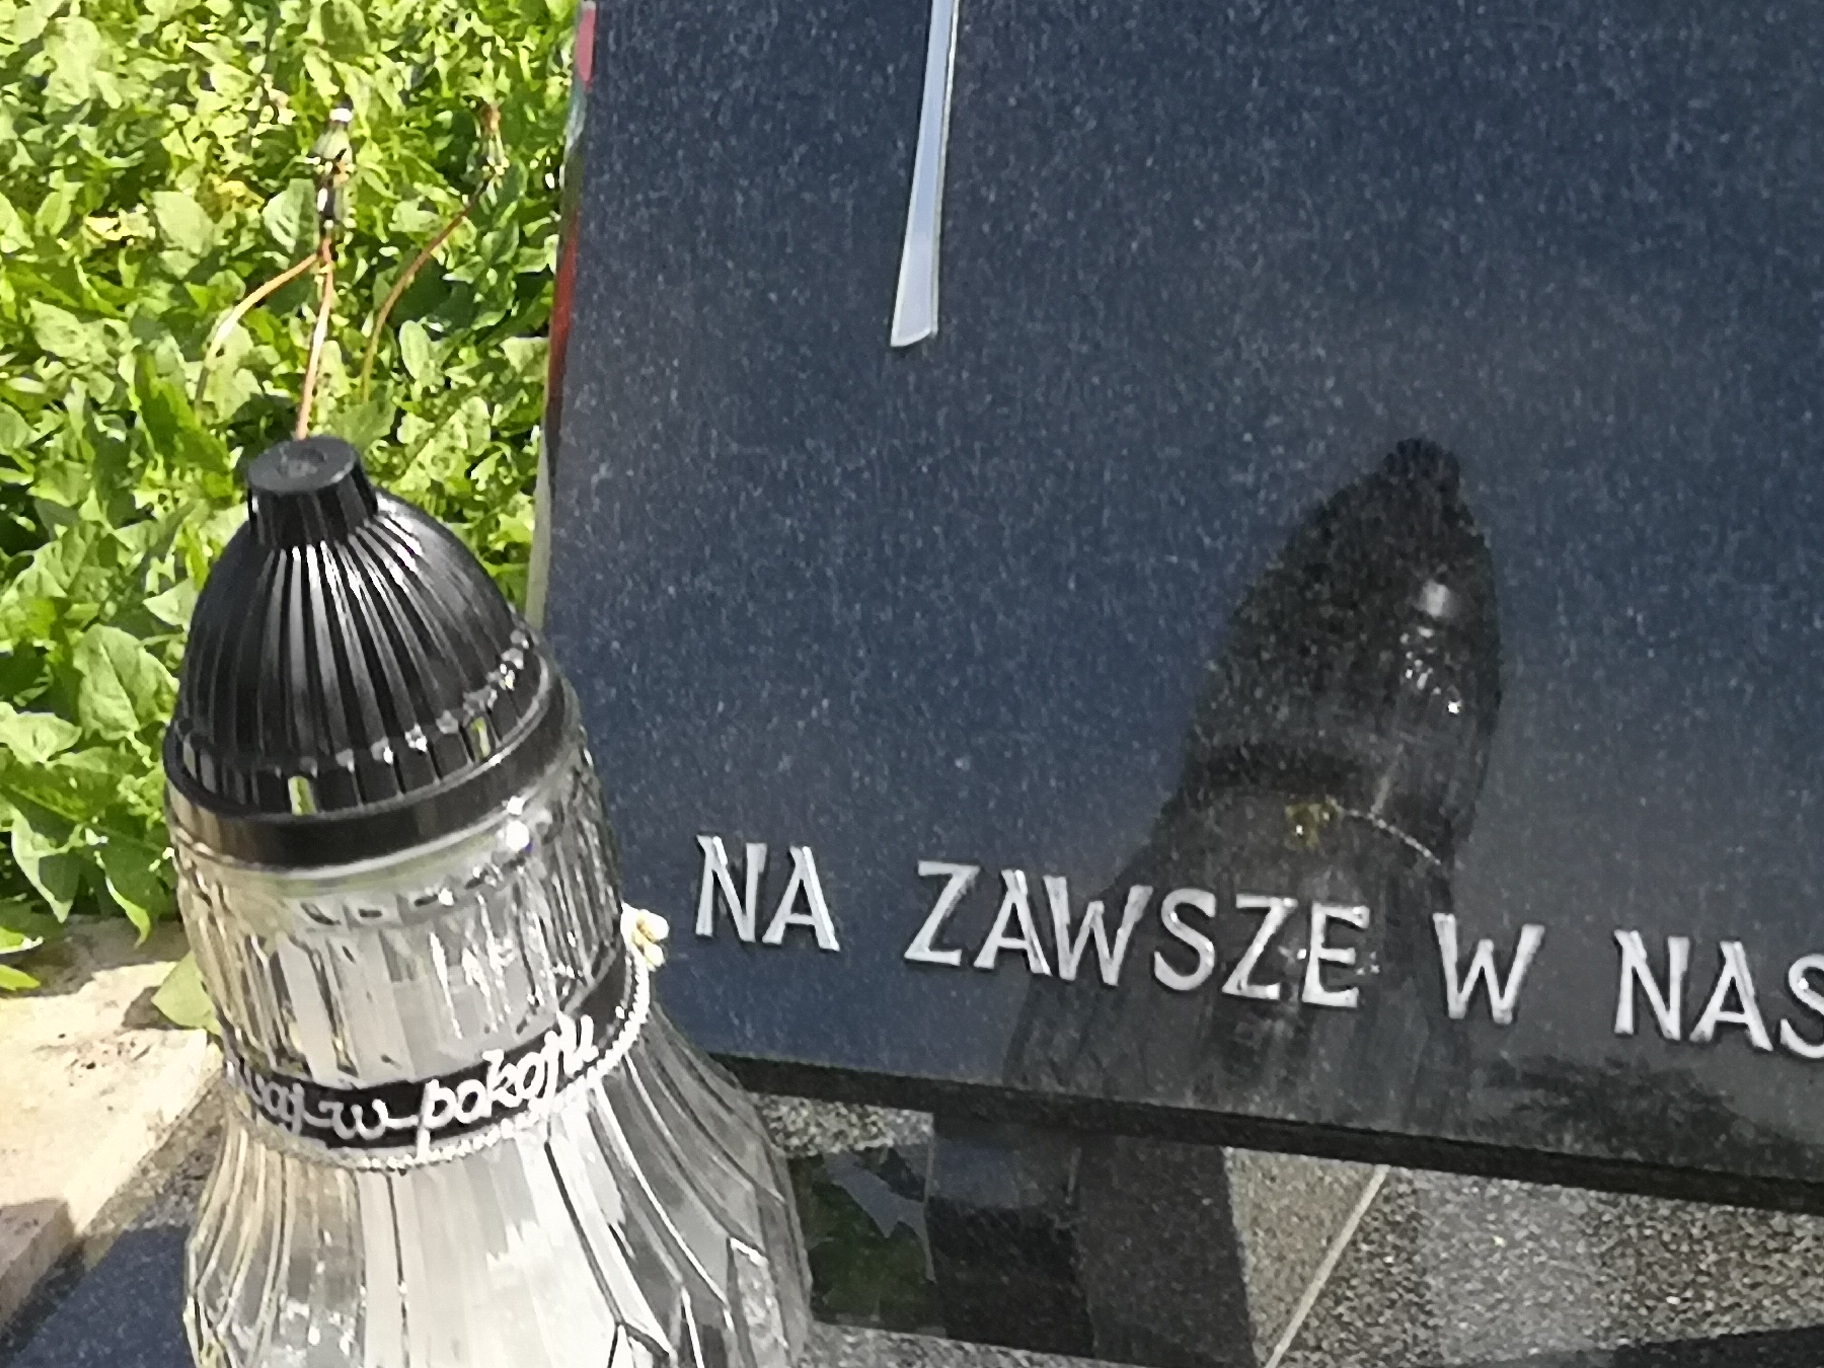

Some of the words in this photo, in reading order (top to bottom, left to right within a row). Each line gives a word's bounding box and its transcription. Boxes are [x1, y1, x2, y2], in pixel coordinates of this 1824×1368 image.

[696, 835, 841, 952] NA
[904, 860, 1370, 1008] ZAWSZE
[1433, 912, 1545, 1024] W
[415, 1011, 600, 1160] pokoju
